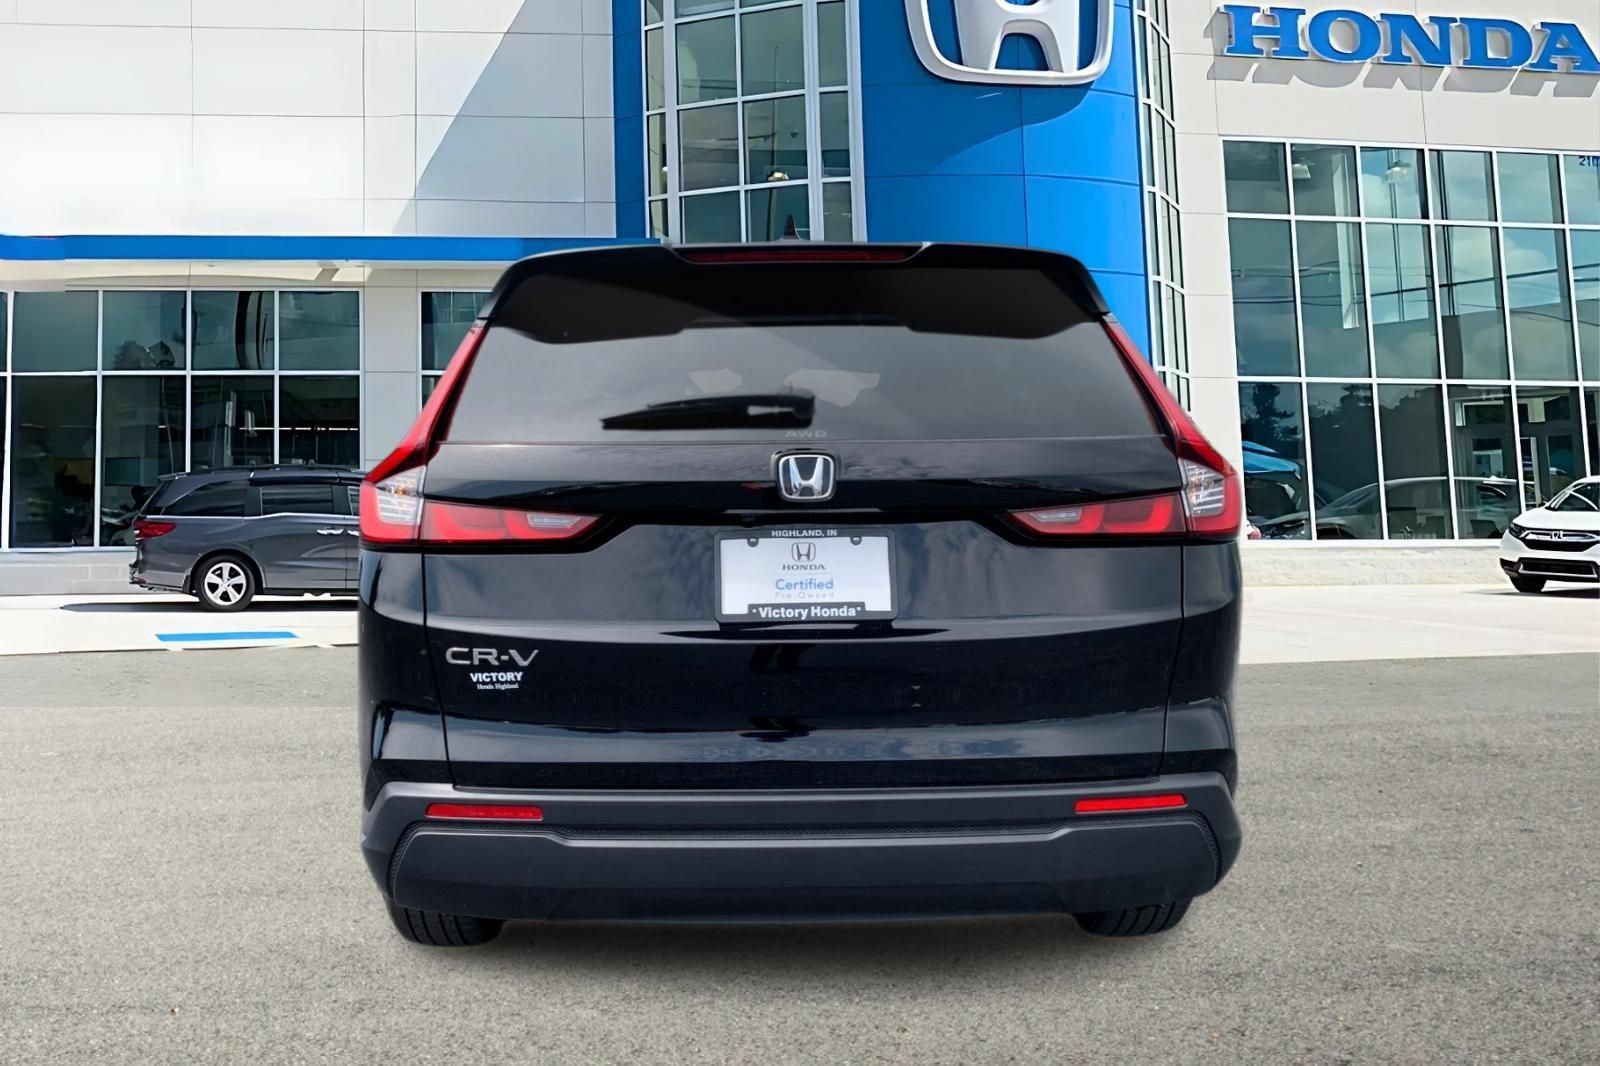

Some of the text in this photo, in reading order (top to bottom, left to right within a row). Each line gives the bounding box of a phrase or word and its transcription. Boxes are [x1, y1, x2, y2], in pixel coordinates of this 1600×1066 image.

[1223, 4, 1600, 74] HONDA
[784, 430, 828, 438] AWD
[771, 529, 838, 538] HIGHLAND, IN
[775, 578, 834, 590] Certified
[758, 605, 857, 620] Victory Honda
[445, 646, 539, 667] CR-V
[470, 671, 523, 682] VICTORY
